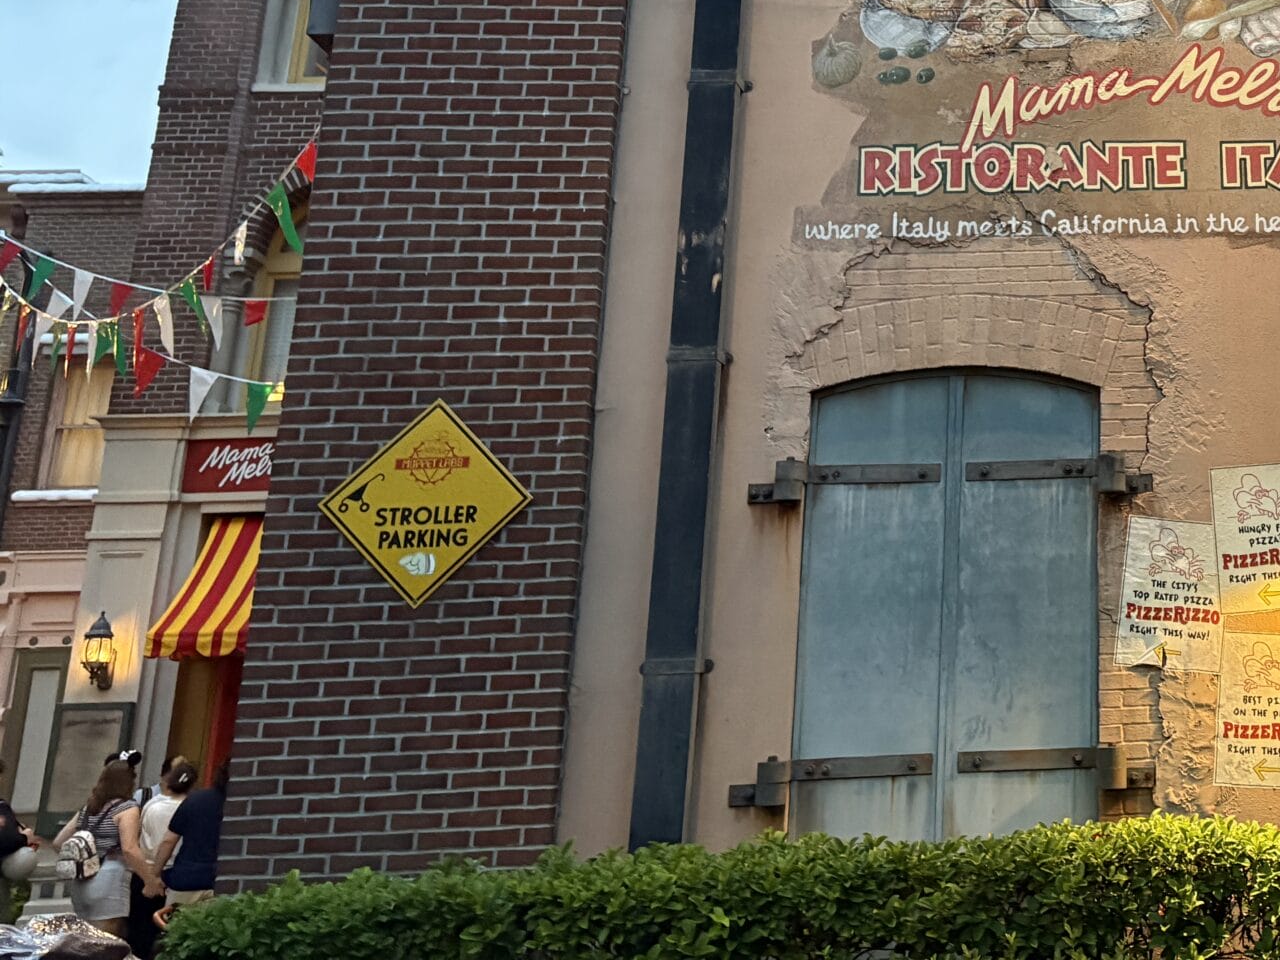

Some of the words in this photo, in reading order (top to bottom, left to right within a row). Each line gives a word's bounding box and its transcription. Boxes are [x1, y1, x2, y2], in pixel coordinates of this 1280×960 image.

[960, 66, 1160, 153] Mama
[859, 139, 1187, 196] RISTORANTE
[805, 219, 882, 240] where
[892, 211, 949, 239] Italy
[956, 215, 1032, 237] meets
[1040, 209, 1169, 236] California
[1173, 213, 1199, 233] in
[1206, 213, 1249, 233] the
[199, 442, 275, 472] Mama
[374, 505, 478, 526] STROLLER
[1238, 523, 1271, 533] HUNGRY
[378, 528, 468, 549] PARKING
[1151, 580, 1167, 589] THE
[1172, 581, 1198, 592] CITY'S
[1229, 573, 1257, 584] RIGHT
[1133, 590, 1149, 600] TOP
[1155, 593, 1178, 602] RATED
[1184, 596, 1213, 605] PIZZA
[1130, 624, 1158, 635] RIGHT
[1163, 628, 1182, 639] THIS
[1188, 630, 1210, 640] WAY!
[1243, 695, 1262, 705] BEST
[1233, 708, 1246, 716] ON
[1251, 709, 1267, 717] THE
[1228, 744, 1256, 755] RIGHT
